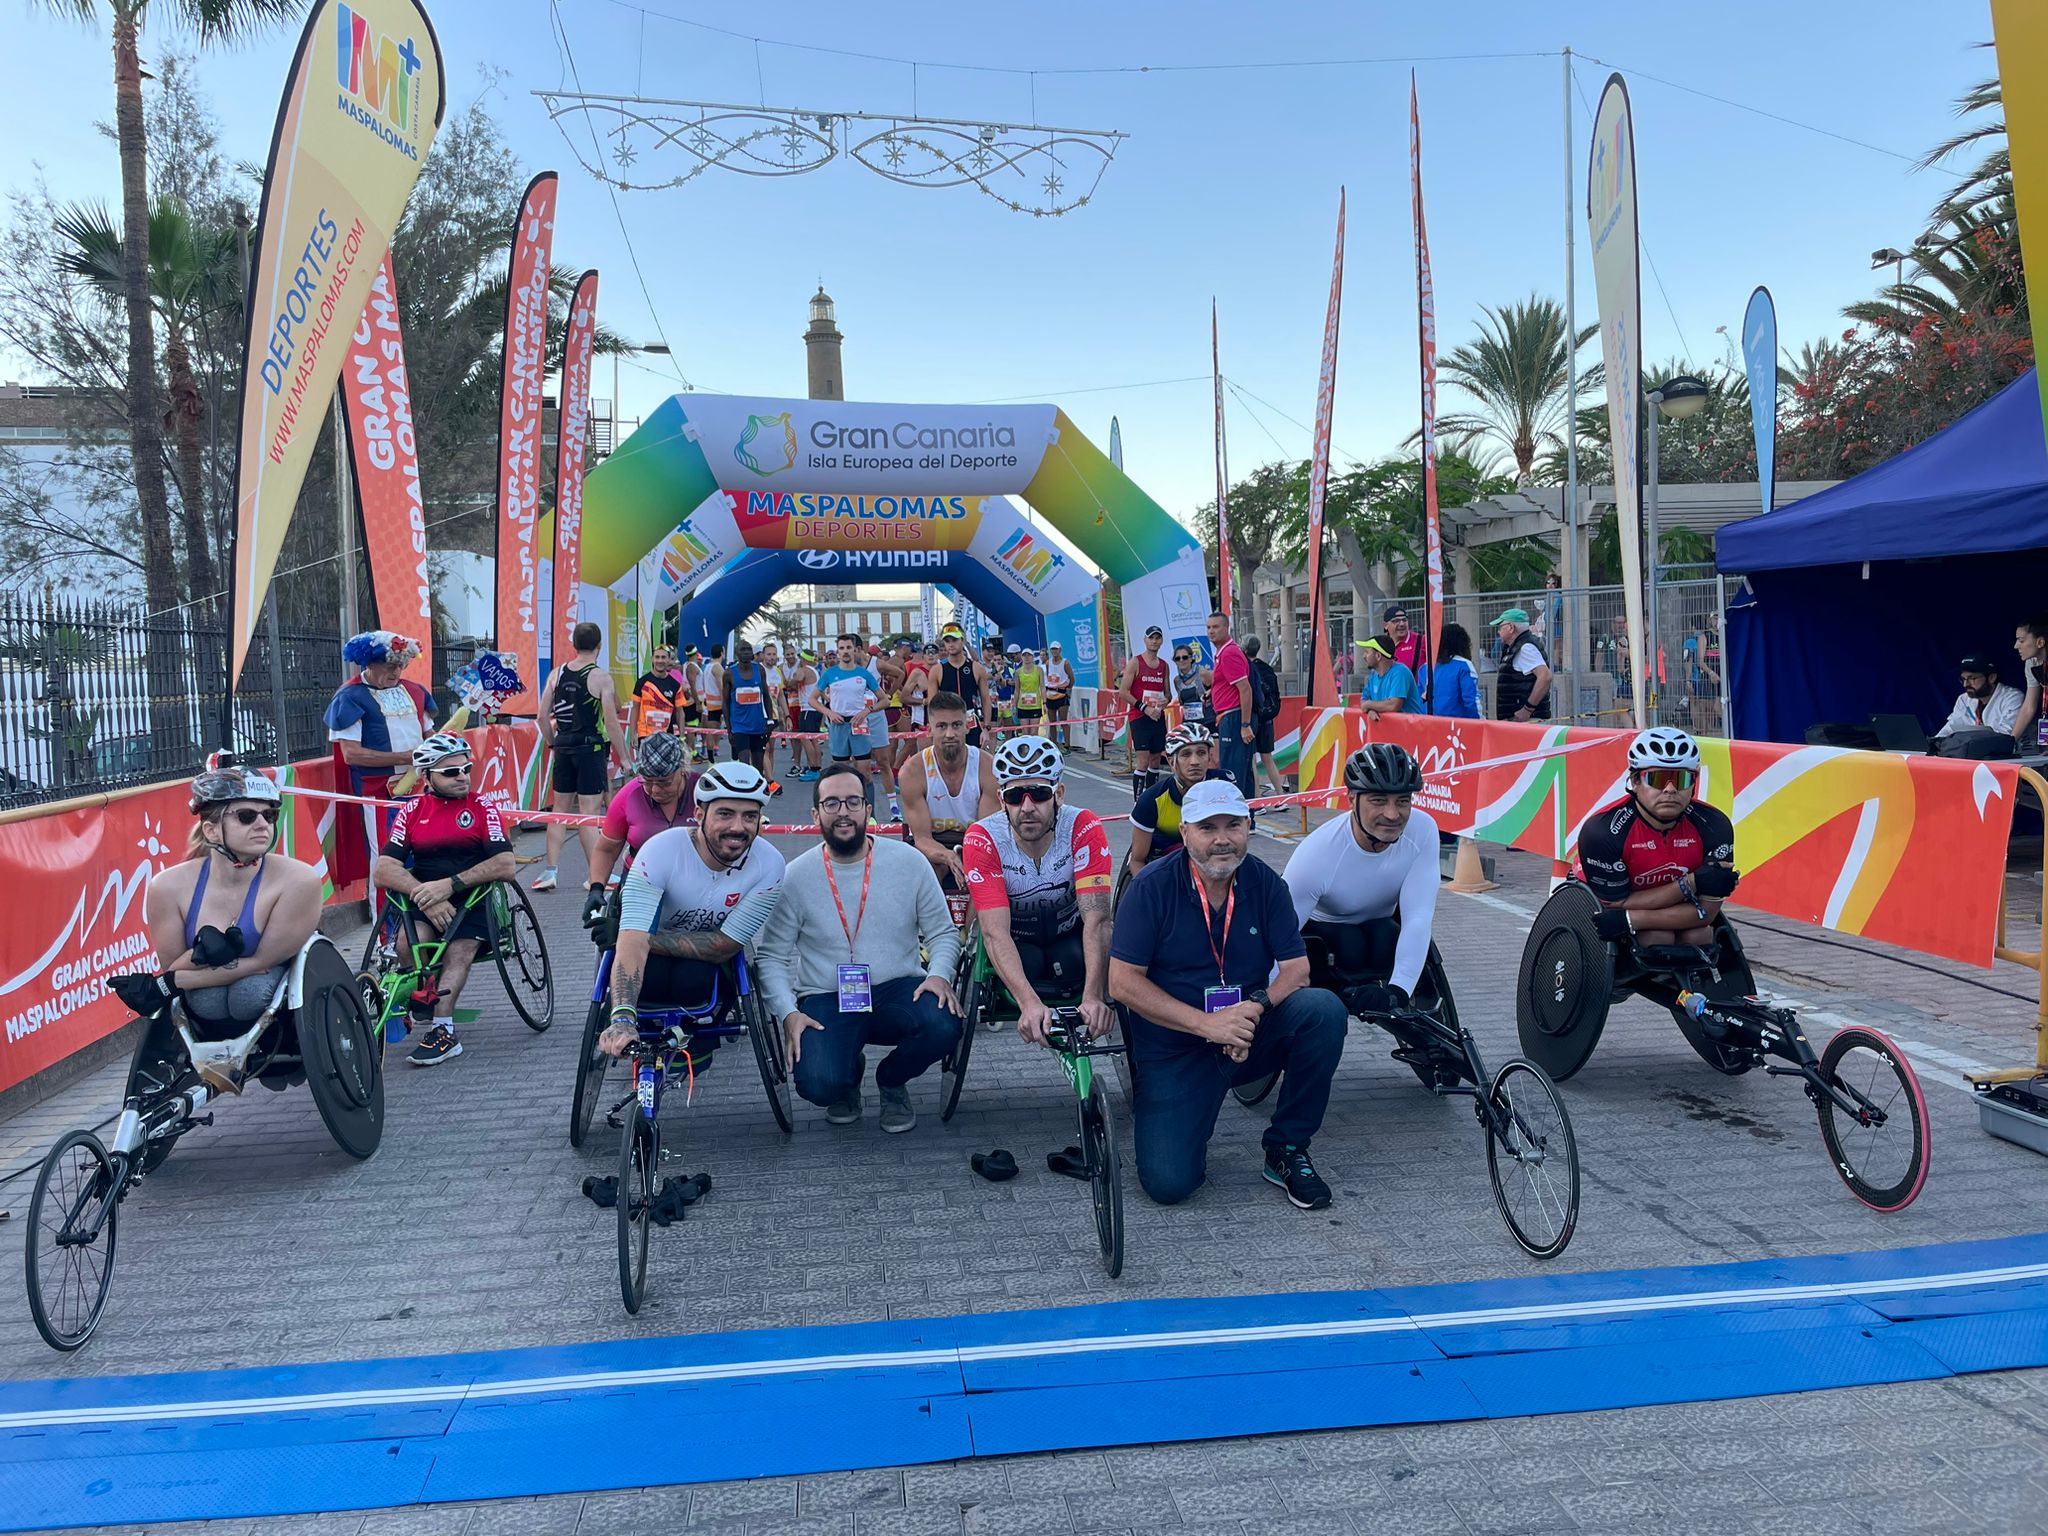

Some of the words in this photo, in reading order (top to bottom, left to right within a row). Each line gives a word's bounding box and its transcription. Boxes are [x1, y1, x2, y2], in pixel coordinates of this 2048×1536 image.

[338, 95, 418, 161] MASPALOMAS
[261, 208, 338, 397] DEPORTES
[269, 217, 366, 465] WWW.MASPALOMAS.COM
[510, 286, 531, 422] CANARIA
[353, 356, 396, 471] GRAN
[811, 420, 889, 450] Gran
[892, 421, 1016, 450] Canaria
[383, 338, 432, 618] MASPALOMAS
[507, 429, 524, 520] GRAN
[808, 453, 838, 469] Isla
[842, 454, 914, 473] Europea
[918, 454, 946, 470] del
[950, 453, 1018, 472] Deporte
[559, 478, 573, 551] GRAN
[747, 491, 967, 521] MASPALOMAS
[794, 520, 923, 541] DEPORTES
[672, 550, 725, 594] MASPALOMAS
[845, 549, 949, 568] HYUNDAI
[989, 554, 1039, 598] MASPALOMAS
[481, 659, 515, 689] VAMOS
[1423, 782, 1452, 799] CANARIA
[1426, 797, 1460, 815] MARATHON
[390, 799, 420, 847] PULPEIOS
[1610, 808, 1635, 835] QUICKIE
[1586, 857, 1613, 870] amlab
[1633, 872, 1679, 886] QUICK
[52, 955, 91, 991] GRAN
[92, 931, 149, 975] CANARIA
[5, 981, 99, 1044] MASPALOMAS
[100, 951, 161, 998] MARATHO
